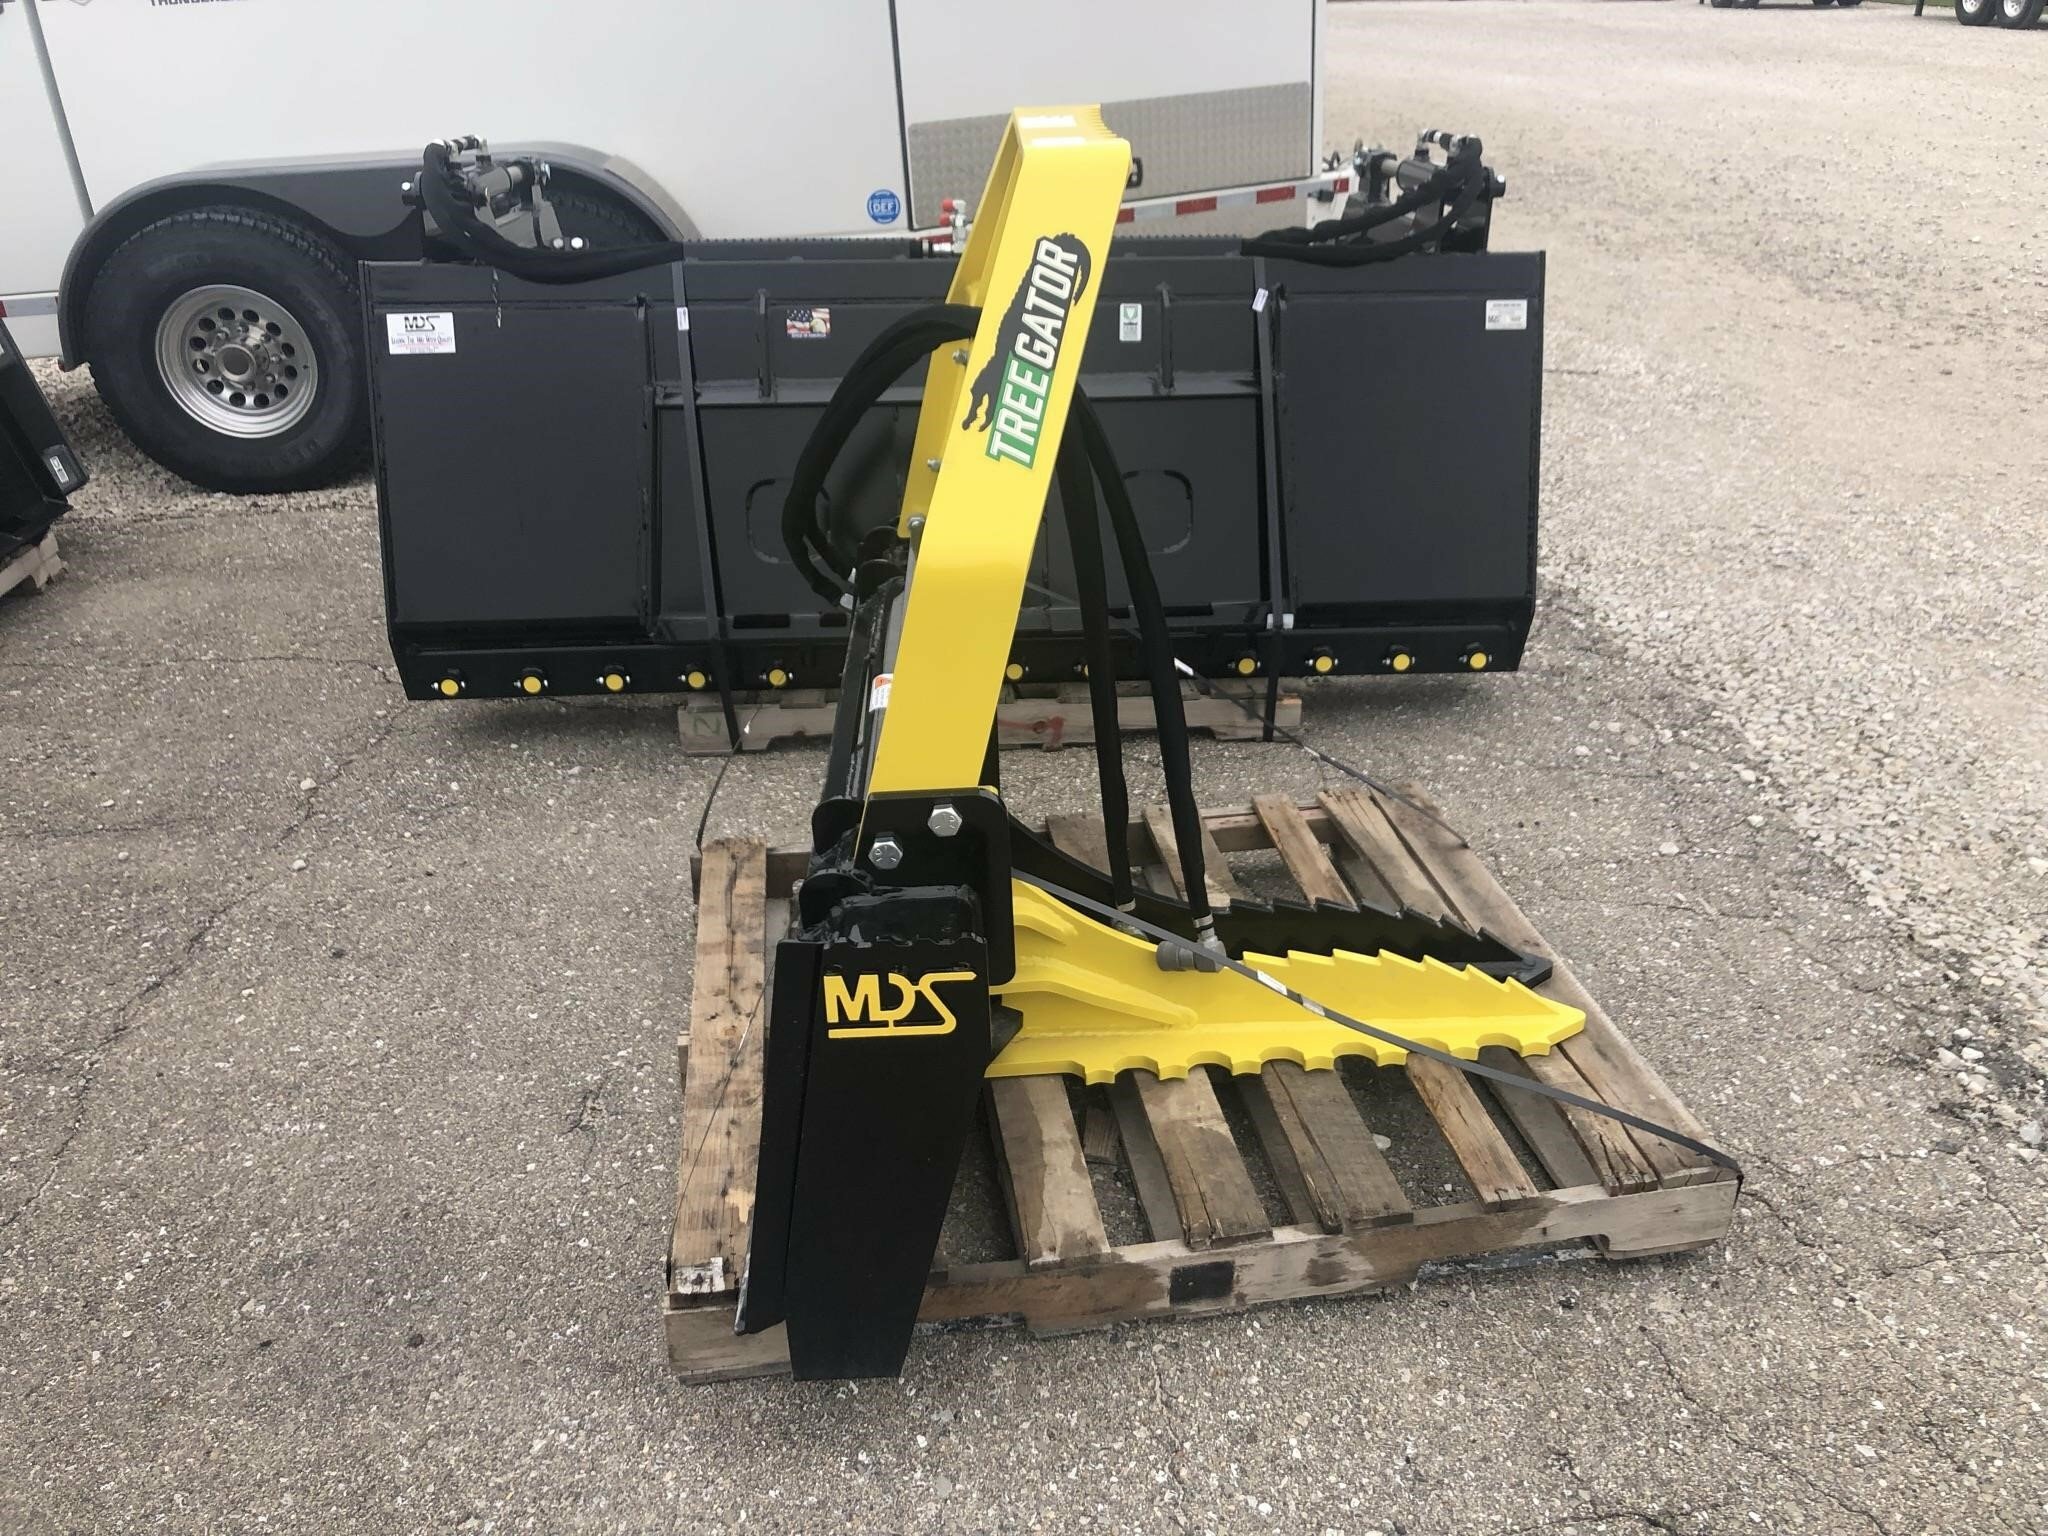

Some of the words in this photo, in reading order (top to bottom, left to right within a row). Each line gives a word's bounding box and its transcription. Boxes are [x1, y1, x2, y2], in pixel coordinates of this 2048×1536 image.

[873, 202, 894, 212] DEF
[404, 315, 440, 332] MDS
[823, 971, 977, 1039] MDS
